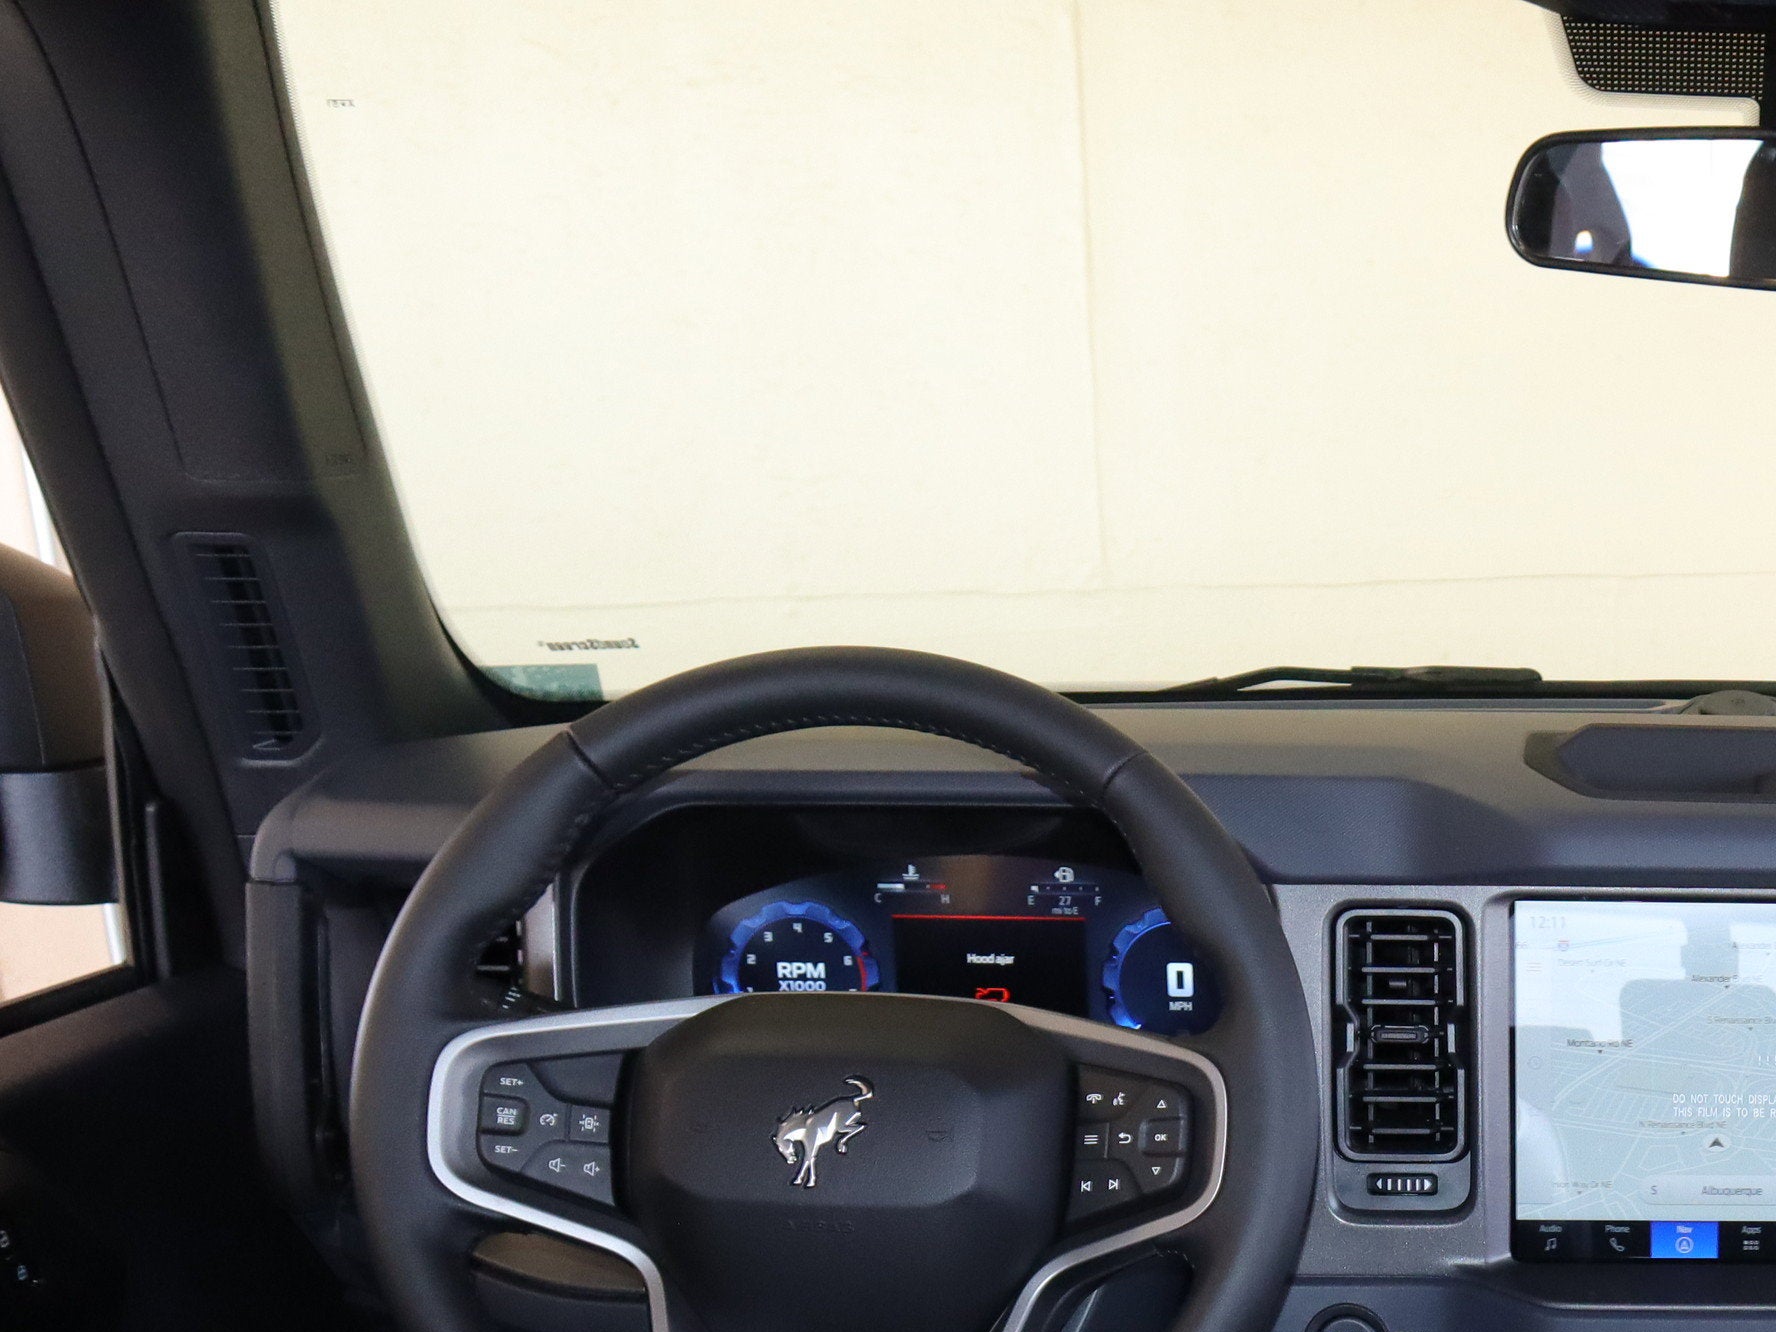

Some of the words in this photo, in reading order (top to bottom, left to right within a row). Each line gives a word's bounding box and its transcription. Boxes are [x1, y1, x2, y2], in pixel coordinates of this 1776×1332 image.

[940, 894, 951, 904] H
[1027, 895, 1035, 906] E
[1058, 896, 1072, 906] 27
[1094, 896, 1102, 906] F
[1530, 915, 1566, 929] 12:11
[763, 931, 774, 943] 3
[823, 932, 834, 944] 5
[746, 954, 757, 965] 2
[843, 955, 853, 966] 6
[966, 953, 995, 965] Hood
[995, 954, 1015, 967] ajar
[776, 962, 826, 979] RPM
[1166, 962, 1194, 997] 0
[1691, 974, 1732, 984] Alexander
[778, 980, 827, 992] X1000
[1168, 1001, 1193, 1011] MPH
[1621, 1038, 1633, 1048] NE
[499, 1077, 524, 1086] SET+
[1672, 1093, 1686, 1104] DO
[1690, 1093, 1708, 1105] NOT
[1713, 1093, 1743, 1105] TOUCH
[496, 1107, 518, 1116] CAN
[1673, 1107, 1693, 1117] THIS
[1697, 1107, 1718, 1118] FILM
[1722, 1107, 1732, 1118] IS
[1736, 1107, 1748, 1118] TO
[1753, 1108, 1765, 1118] BE
[496, 1117, 516, 1126] RES
[1154, 1133, 1167, 1141] OK
[1650, 1185, 1658, 1196] S
[1701, 1185, 1763, 1198] Albuquerque
[1539, 1224, 1563, 1233] Audio
[1605, 1225, 1631, 1234] Phone
[1676, 1225, 1693, 1234] Nav
[1741, 1225, 1762, 1236] Apps
